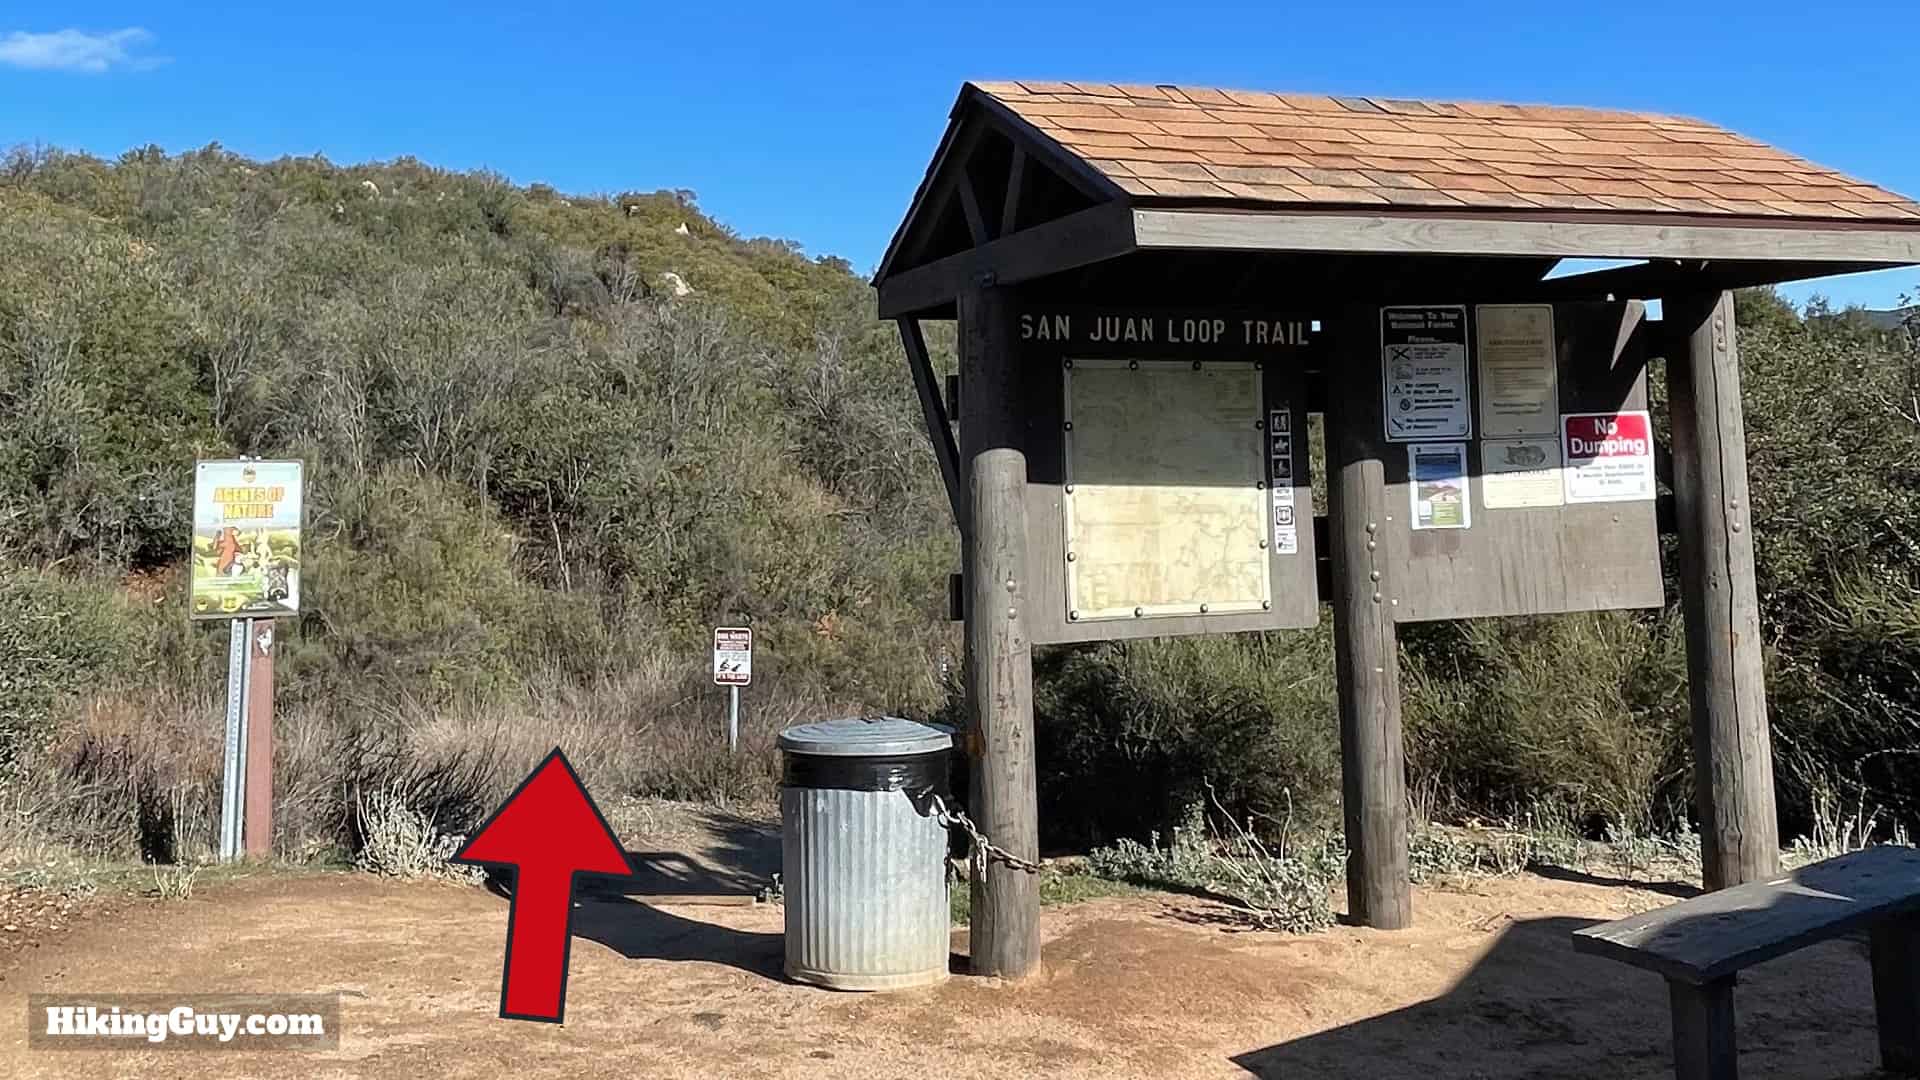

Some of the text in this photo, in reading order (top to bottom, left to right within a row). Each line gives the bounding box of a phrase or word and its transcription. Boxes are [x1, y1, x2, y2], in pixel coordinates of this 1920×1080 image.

[1021, 314, 1309, 345] SAN JUAN LOOP TRAIL
[1594, 418, 1618, 436] No
[1571, 435, 1646, 456] Dumping
[213, 486, 284, 503] AGENTS OF
[223, 504, 274, 519] NATURE
